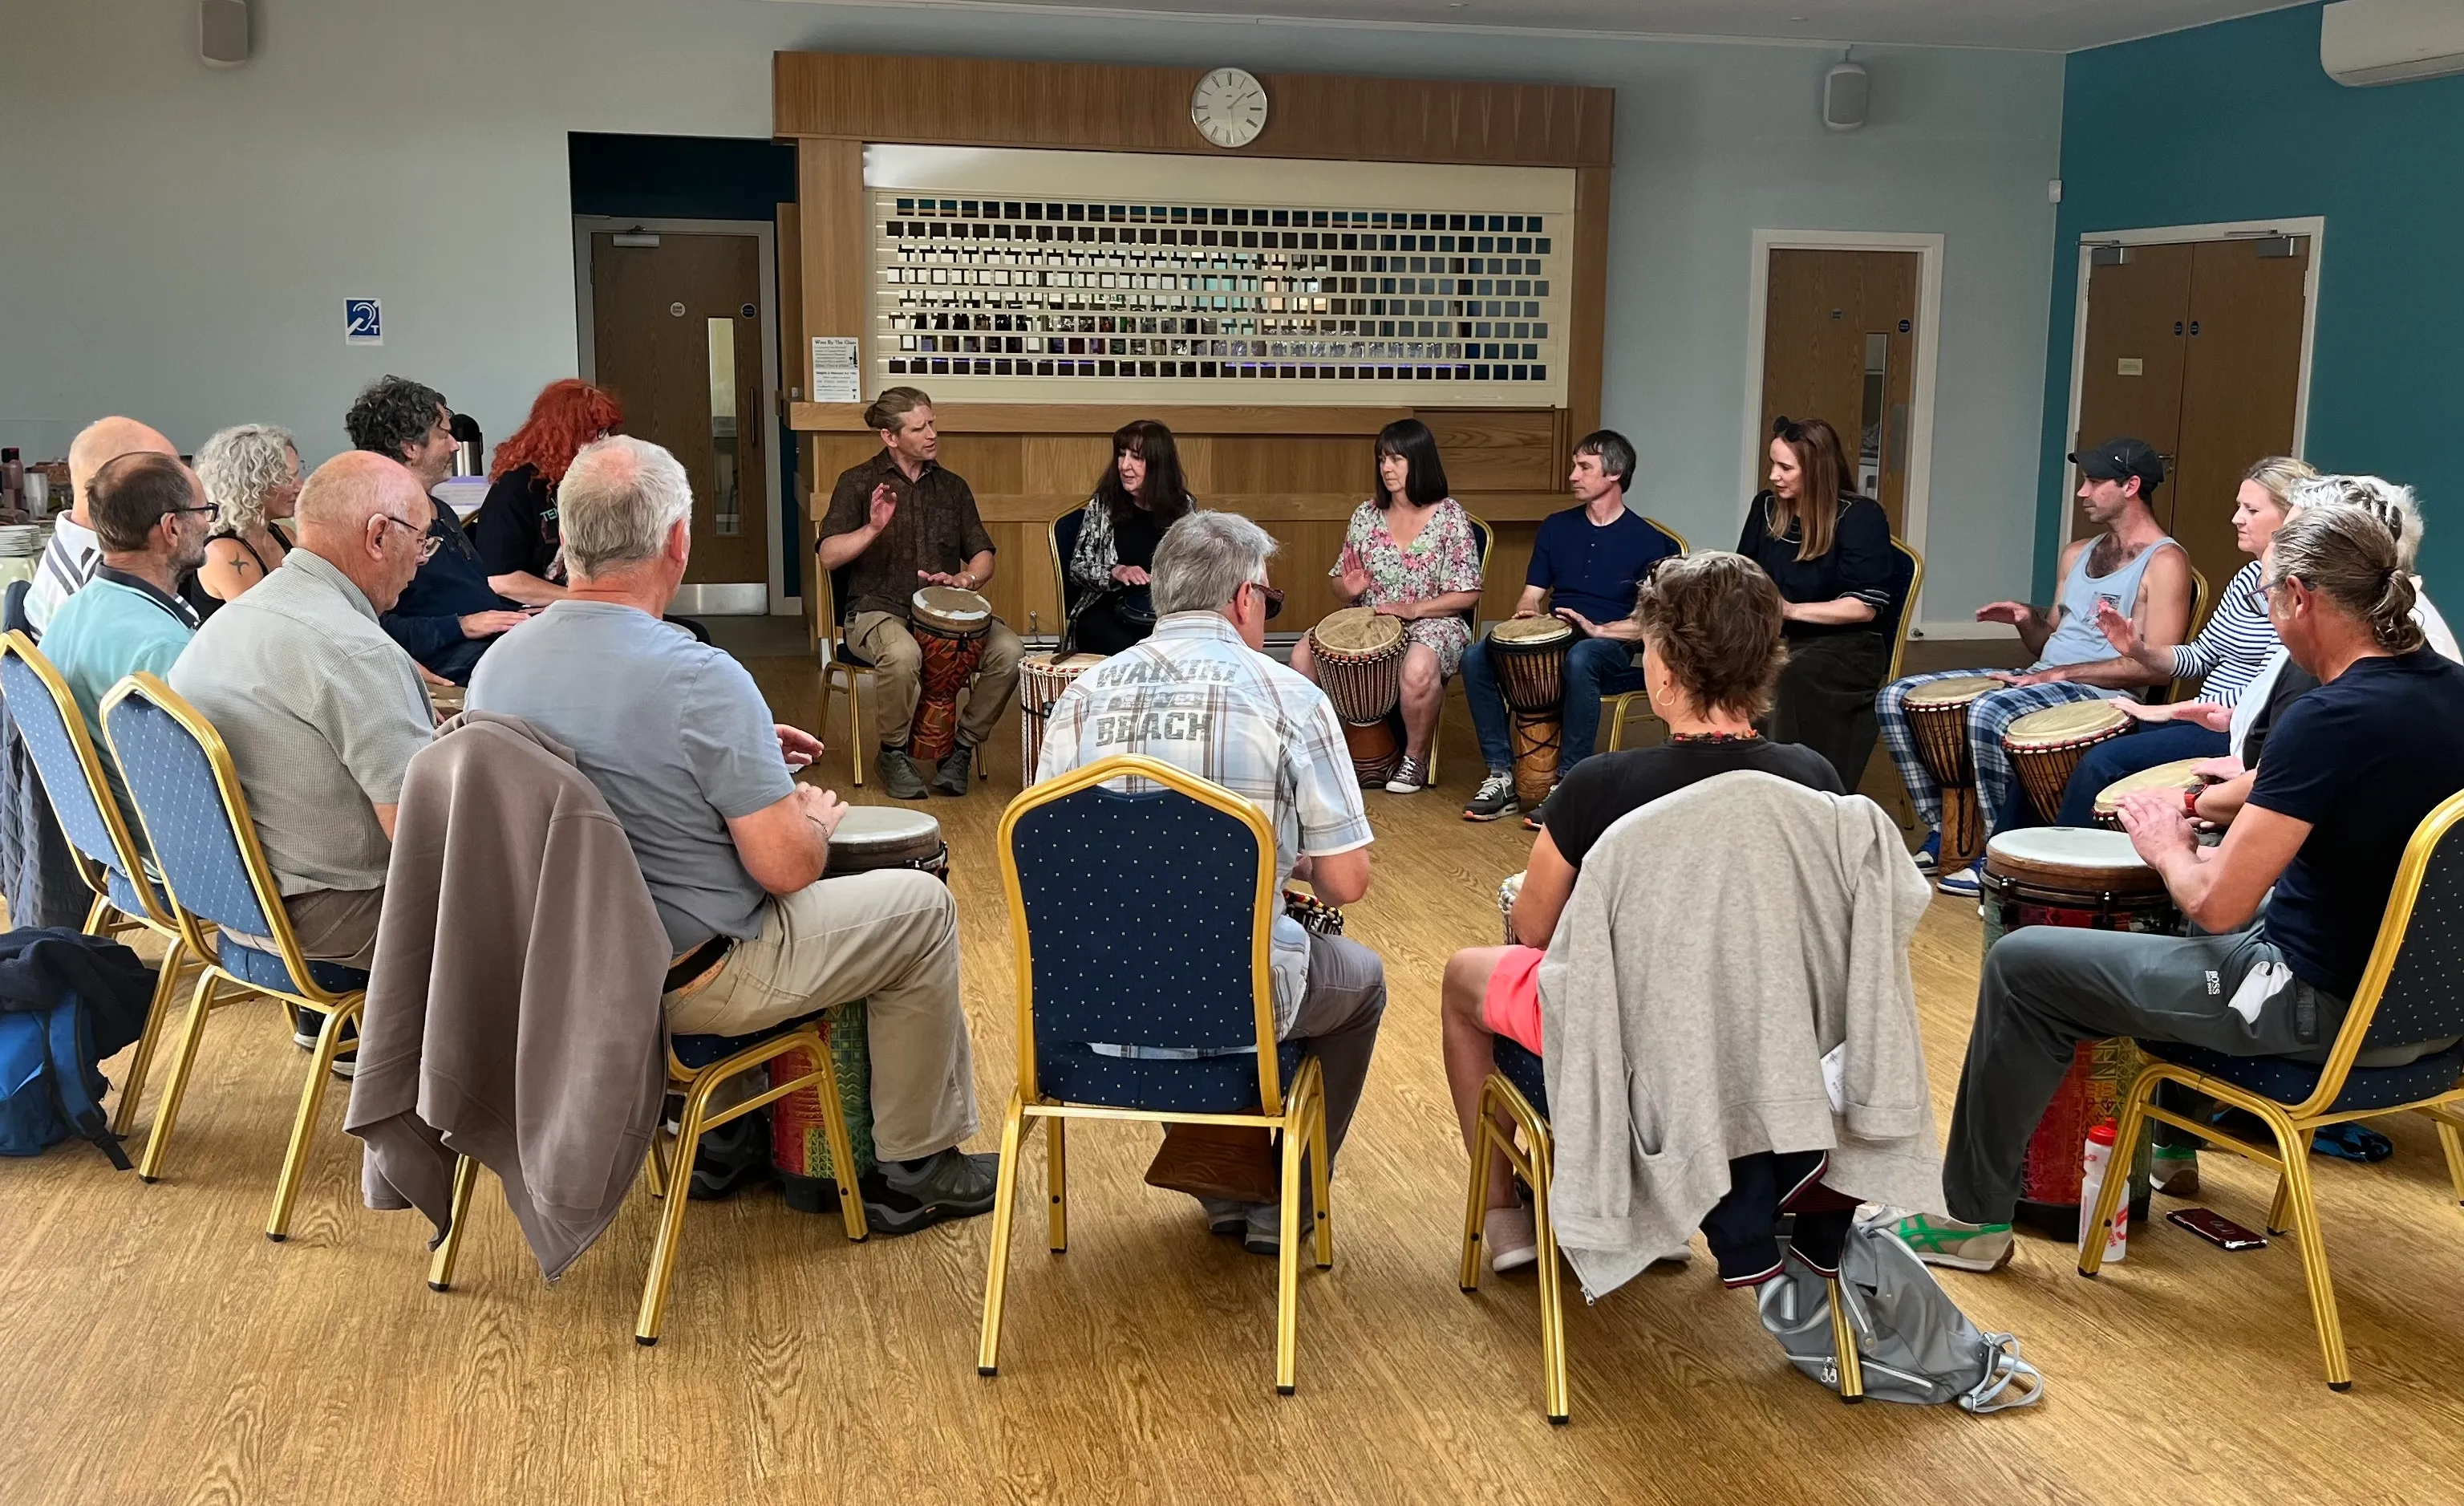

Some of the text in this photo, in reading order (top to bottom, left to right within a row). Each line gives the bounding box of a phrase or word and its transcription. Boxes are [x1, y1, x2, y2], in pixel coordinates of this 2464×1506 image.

[371, 325, 379, 335] T
[1096, 712, 1212, 747] BEACH
[2209, 971, 2221, 995] BOSS
